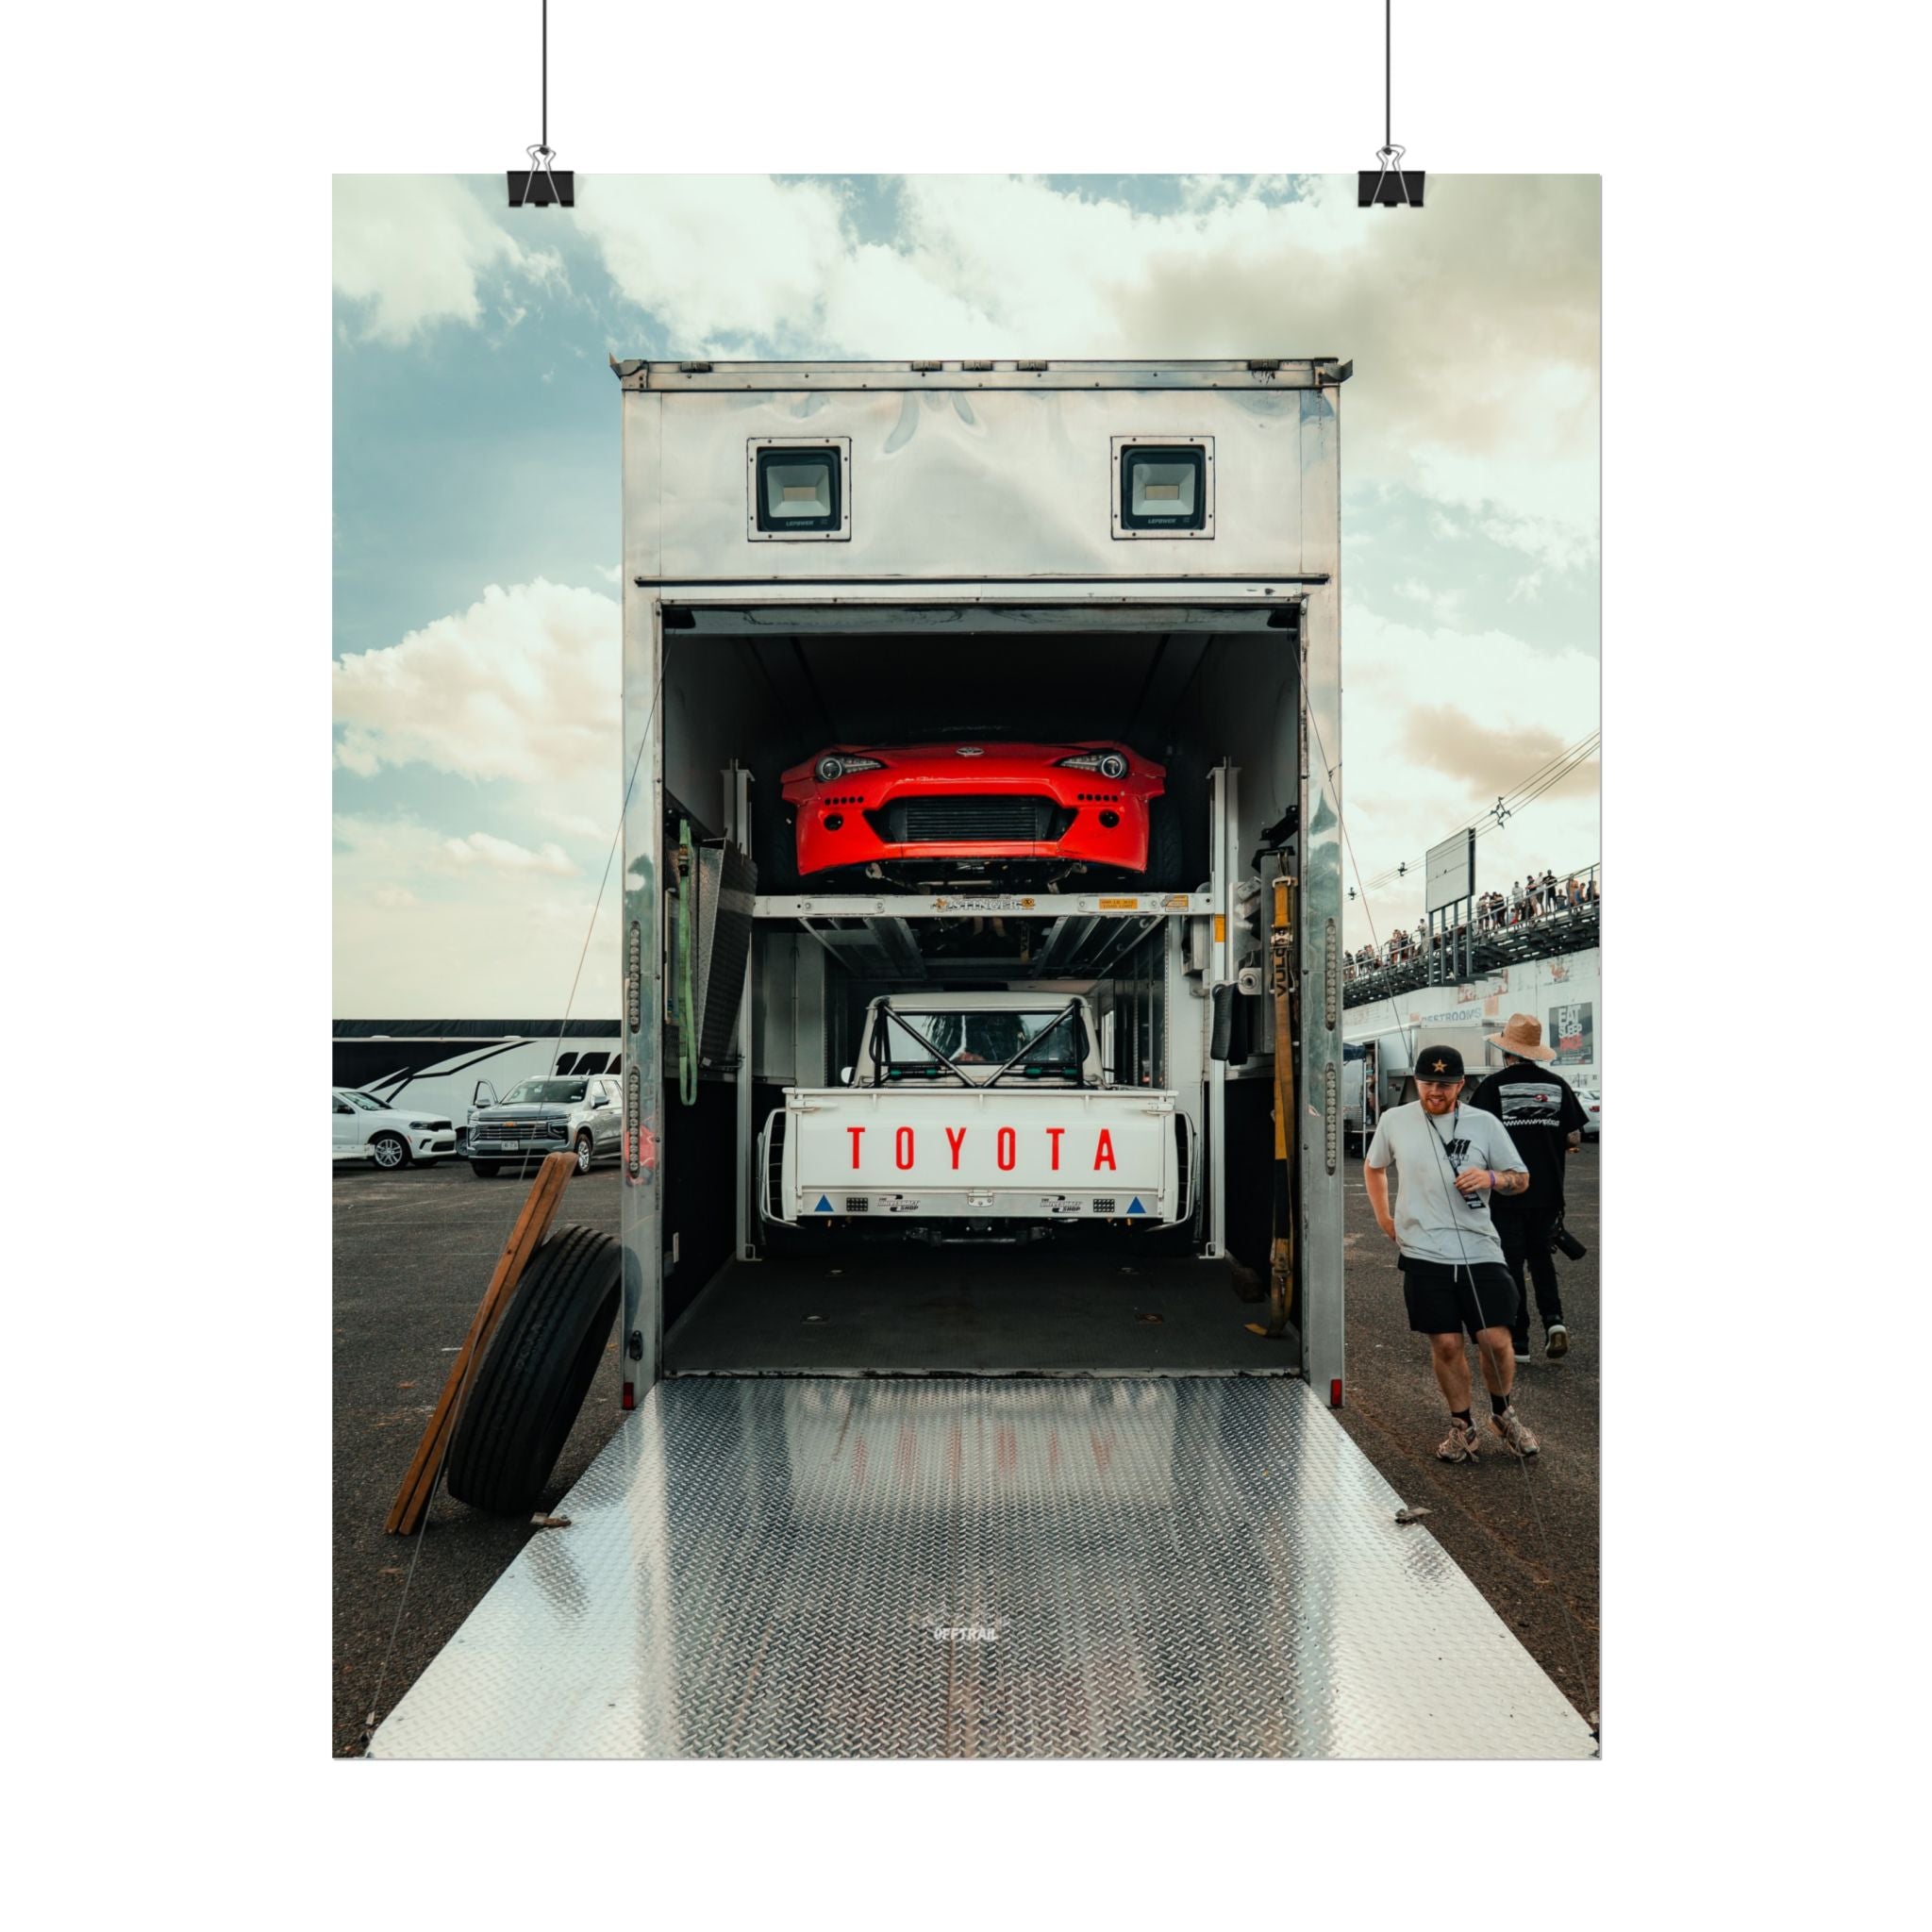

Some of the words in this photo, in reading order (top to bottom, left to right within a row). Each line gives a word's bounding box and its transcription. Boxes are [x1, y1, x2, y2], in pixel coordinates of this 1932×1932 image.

[950, 898, 1021, 910] STINGER
[1557, 1004, 1582, 1027] EAT
[847, 1126, 1117, 1171] TOYOTA
